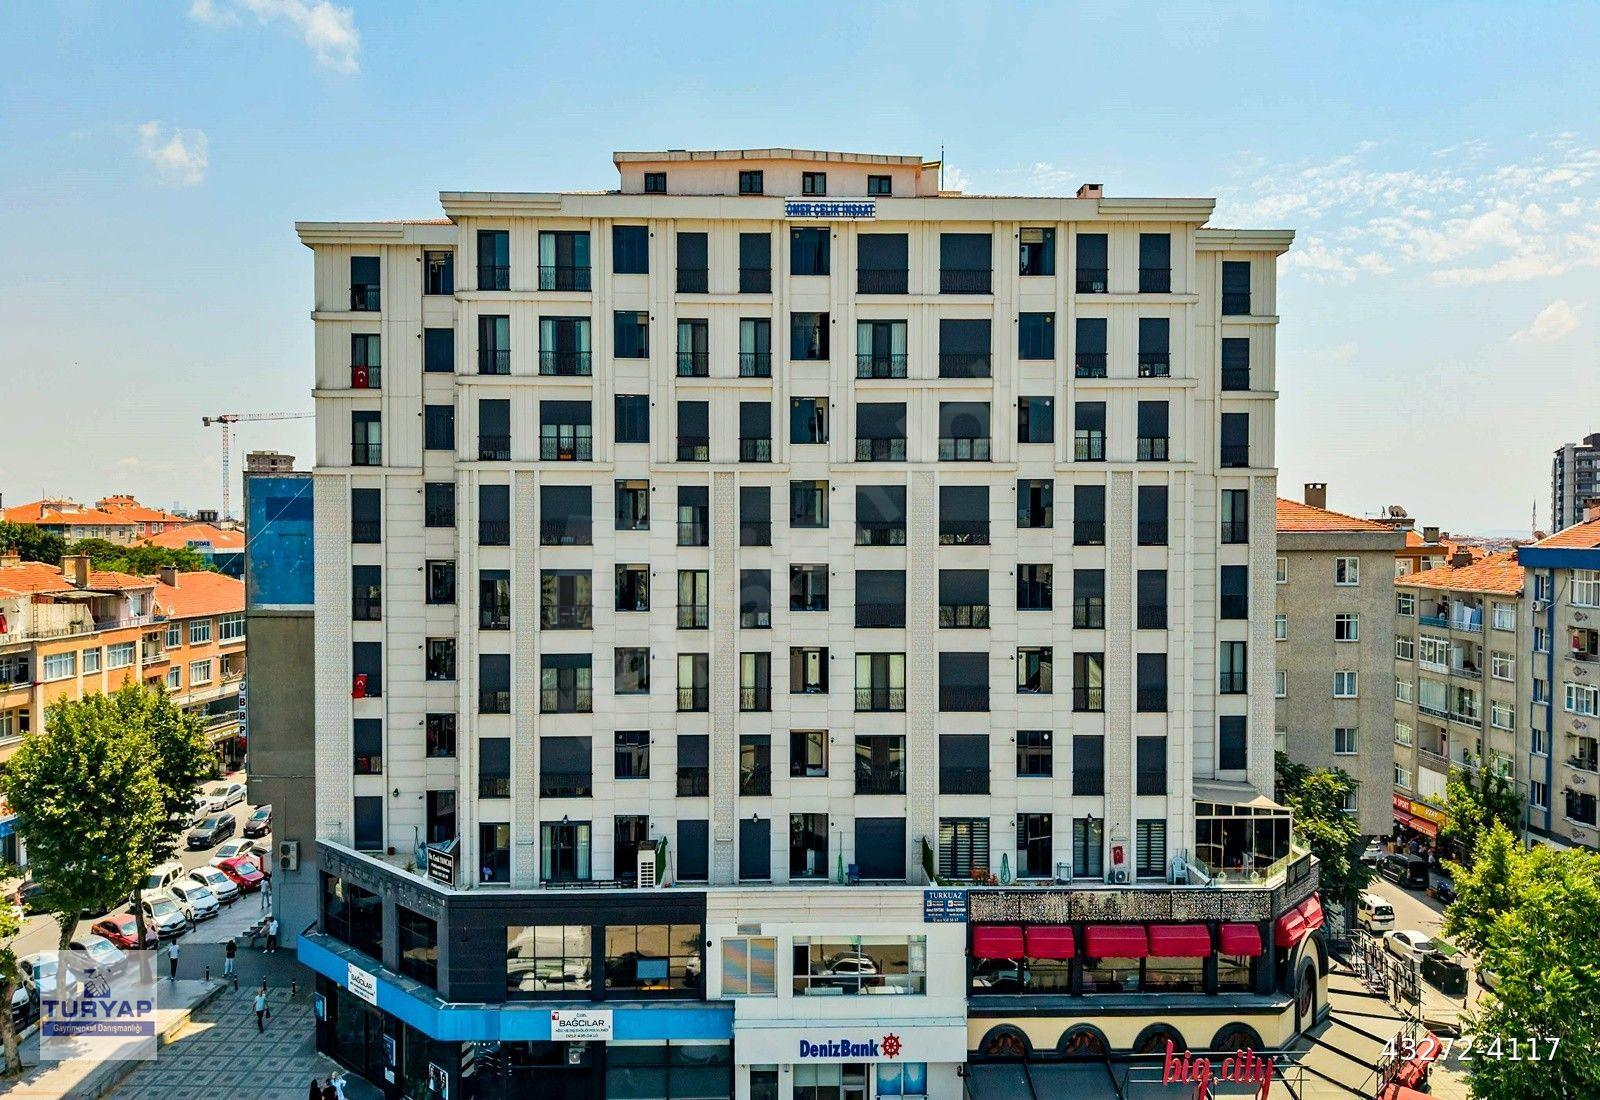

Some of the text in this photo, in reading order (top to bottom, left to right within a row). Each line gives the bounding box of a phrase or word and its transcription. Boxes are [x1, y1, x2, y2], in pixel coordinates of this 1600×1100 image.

[559, 1018, 605, 1027] BAĞCILAR
[799, 1039, 879, 1058] DenizBank
[1162, 1039, 1273, 1100] big city
